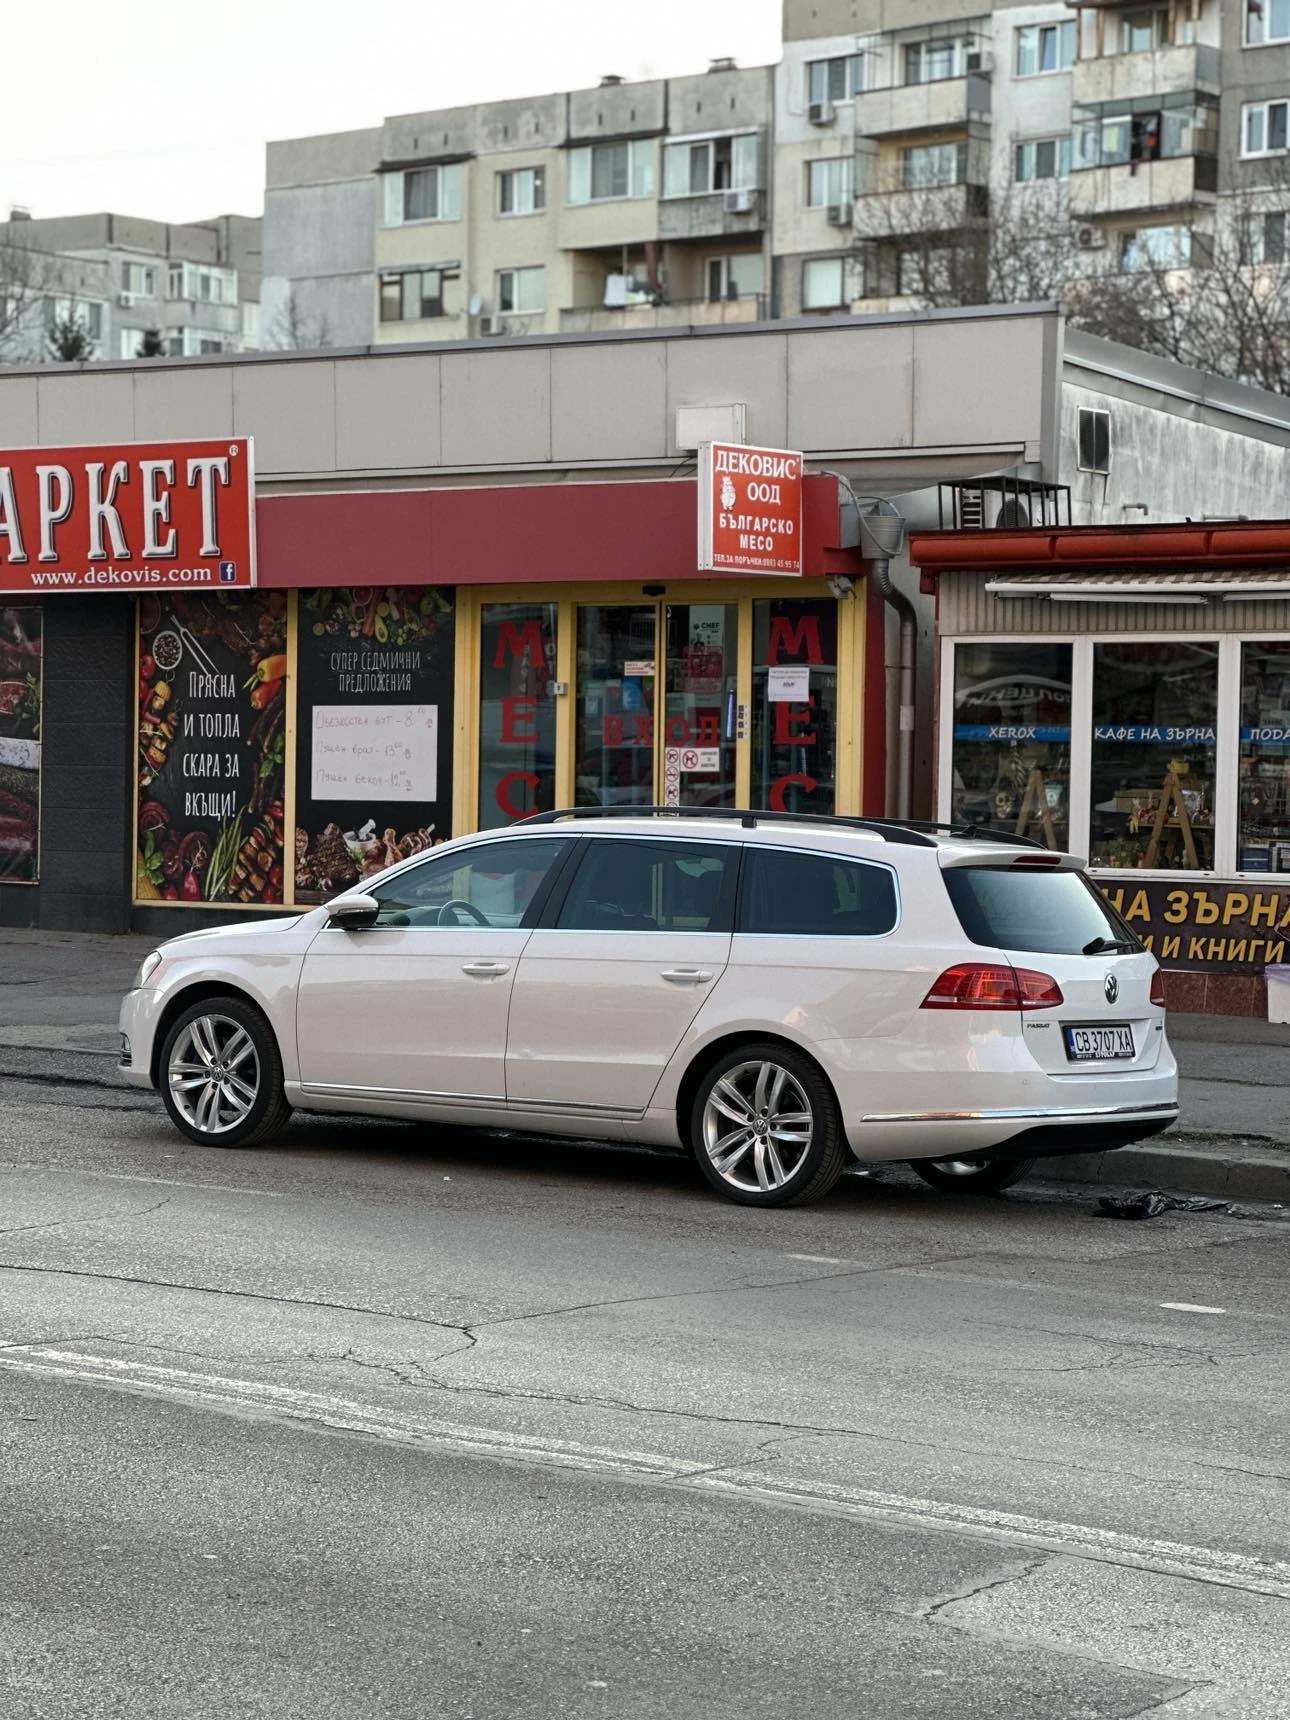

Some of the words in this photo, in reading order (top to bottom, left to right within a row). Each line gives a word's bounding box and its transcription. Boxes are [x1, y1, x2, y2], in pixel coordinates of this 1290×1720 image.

[714, 450, 797, 480] ДЕКОВИС
[747, 482, 781, 506] ООД
[719, 513, 794, 535] БЪЛГАРСКО
[739, 533, 774, 552] МЕСО
[31, 566, 212, 585] www.dekovis.com
[330, 652, 358, 671] СУПЕР
[361, 651, 421, 671] СЕДМИЧНИ
[189, 671, 236, 698] ПРЯСНА
[339, 673, 412, 693] ПРЕДЛОЖЕНИЯ
[184, 714, 194, 737] И
[199, 713, 241, 738] ТОПЛА
[603, 714, 721, 748] ВХОД
[988, 727, 1036, 739] XEROX
[1094, 727, 1135, 741] КАФЕ
[1141, 727, 1162, 741] НА
[1166, 727, 1216, 741] ЗЪРНА
[183, 753, 220, 777] СКАРА
[224, 753, 240, 778] ЗА
[185, 791, 237, 822] ВКЪЩИ!
[1161, 935, 1181, 959] И
[1188, 937, 1286, 963] КНИГИ
[1091, 1031, 1115, 1051] 3707
